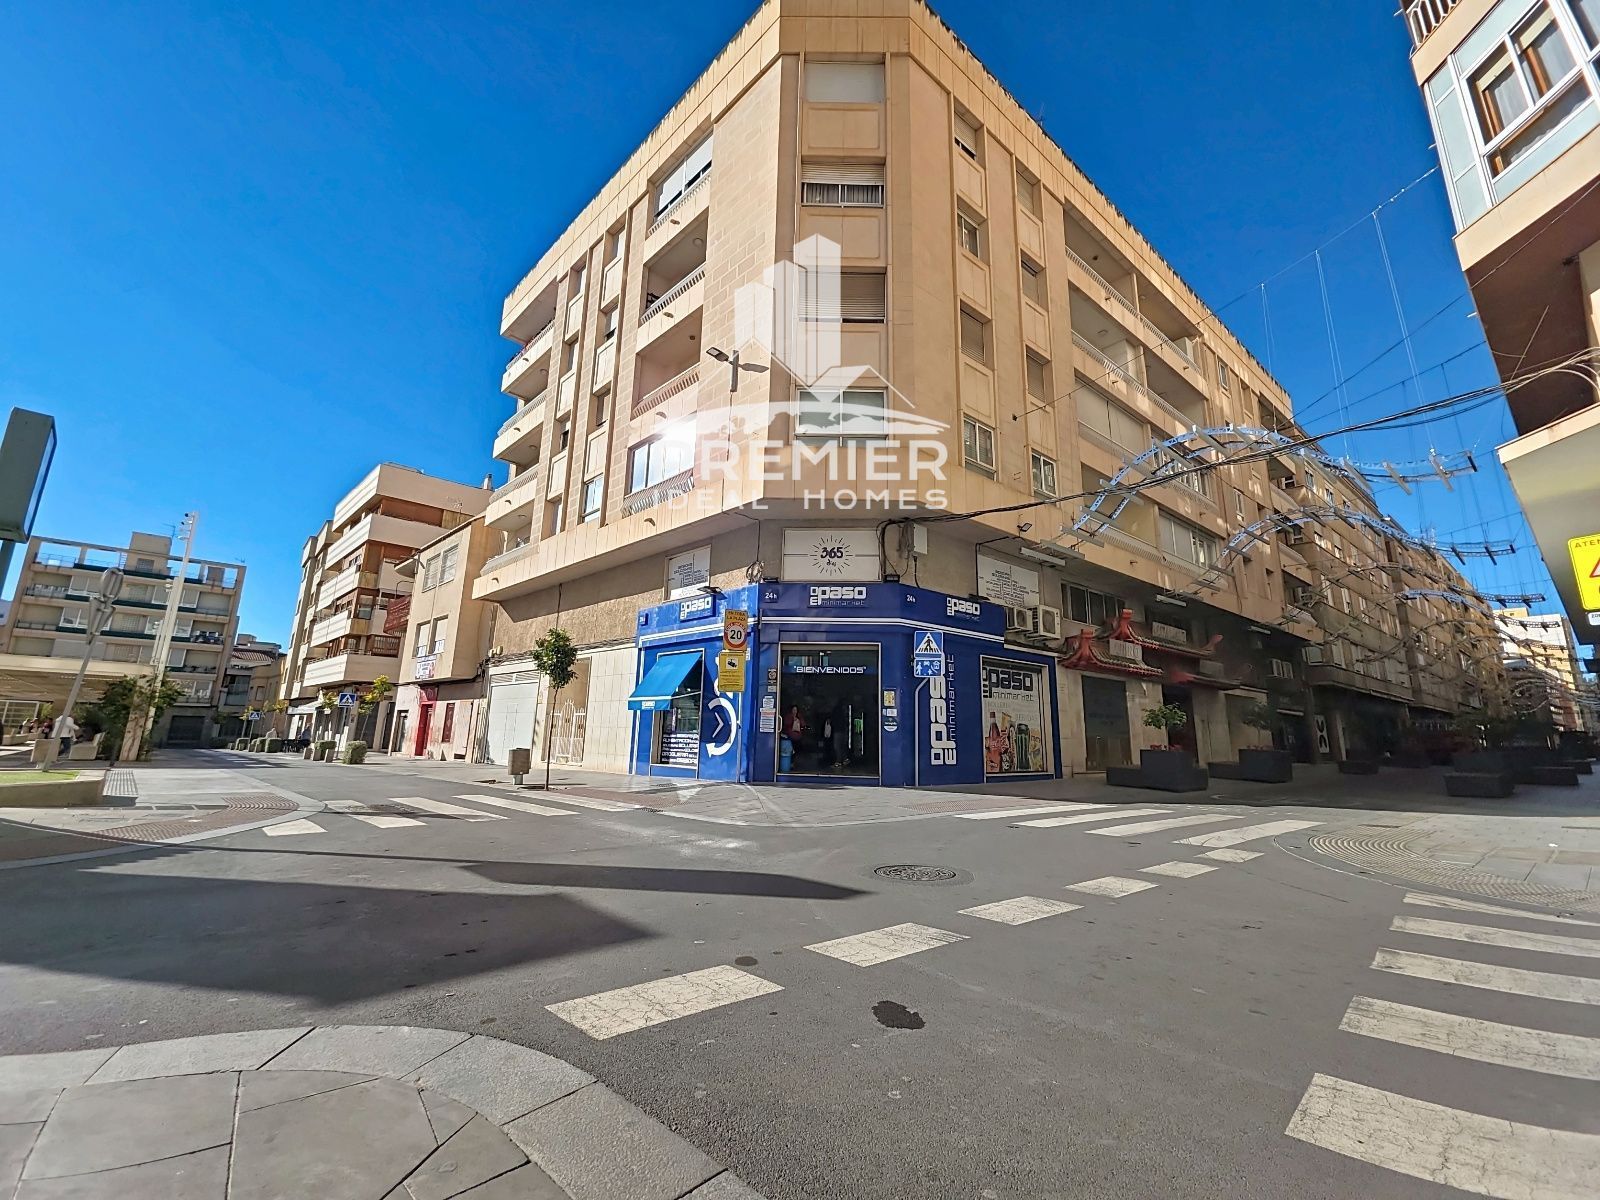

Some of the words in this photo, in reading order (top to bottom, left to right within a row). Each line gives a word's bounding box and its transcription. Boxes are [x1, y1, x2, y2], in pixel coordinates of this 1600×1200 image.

[820, 546, 844, 559] 365
[730, 629, 742, 640] 20
[929, 651, 957, 749] pas
[947, 654, 956, 741] minimarket
[992, 691, 1034, 702] minimarket
